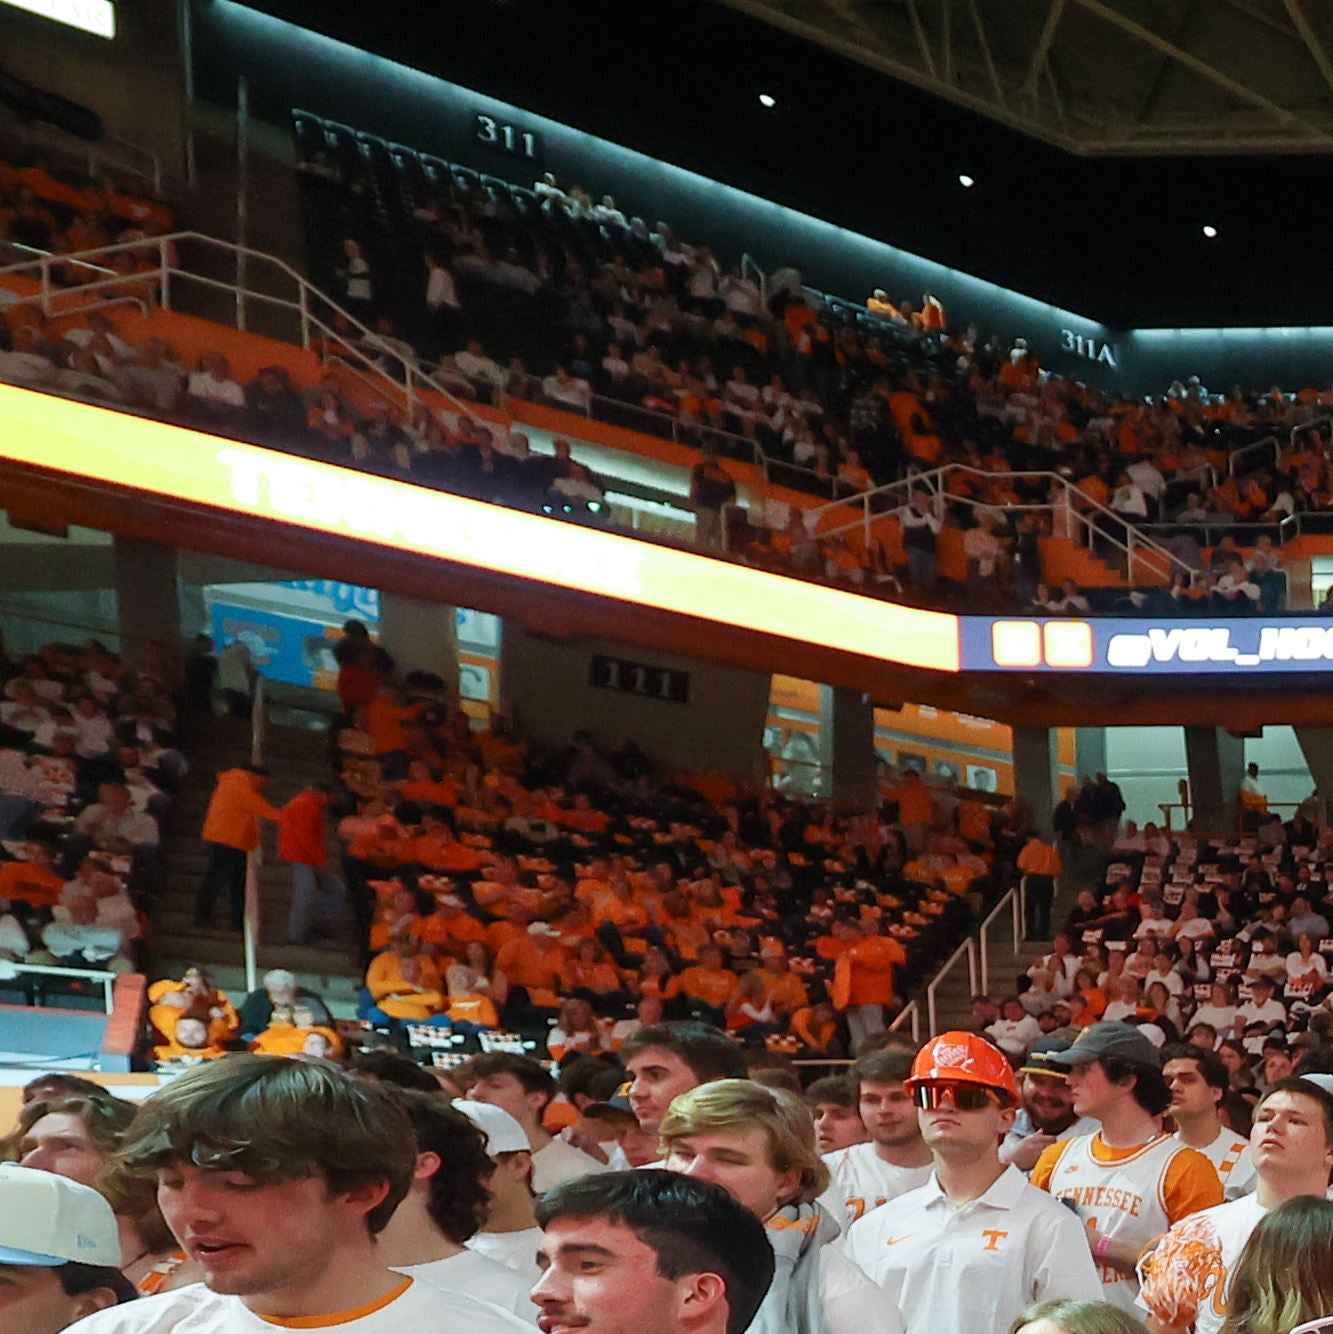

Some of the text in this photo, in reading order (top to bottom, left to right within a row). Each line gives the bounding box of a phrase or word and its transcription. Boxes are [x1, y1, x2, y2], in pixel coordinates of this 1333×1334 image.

[476, 114, 537, 158] 311
[1060, 327, 1118, 367] 311A
[607, 658, 673, 694] 111
[981, 1229, 1009, 1251] T
